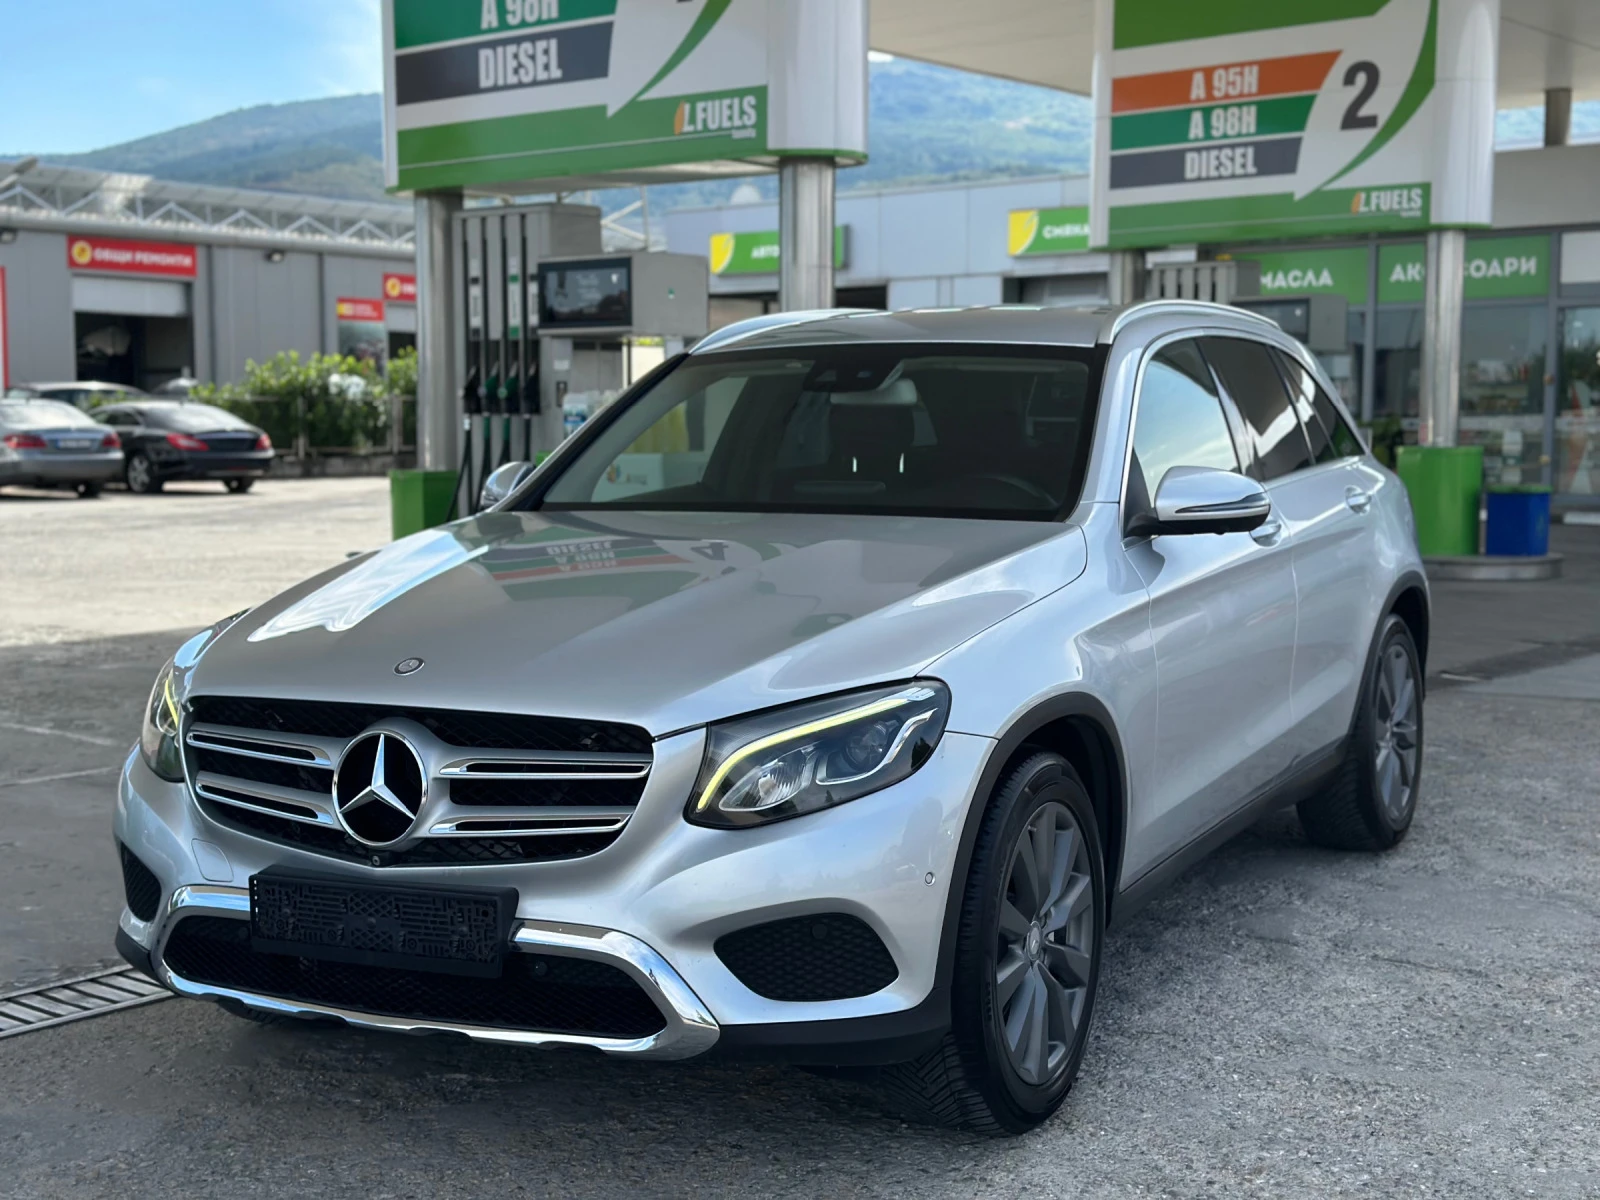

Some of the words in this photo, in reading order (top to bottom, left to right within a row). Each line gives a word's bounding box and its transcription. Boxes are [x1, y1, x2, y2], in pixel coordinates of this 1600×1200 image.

[478, 38, 563, 89] DIESEL
[1189, 70, 1206, 101] A
[1212, 65, 1259, 98] 95H
[1340, 60, 1380, 131] 2
[1188, 110, 1204, 140] A
[1211, 104, 1257, 137] 98H
[1184, 146, 1258, 180] DIESEL
